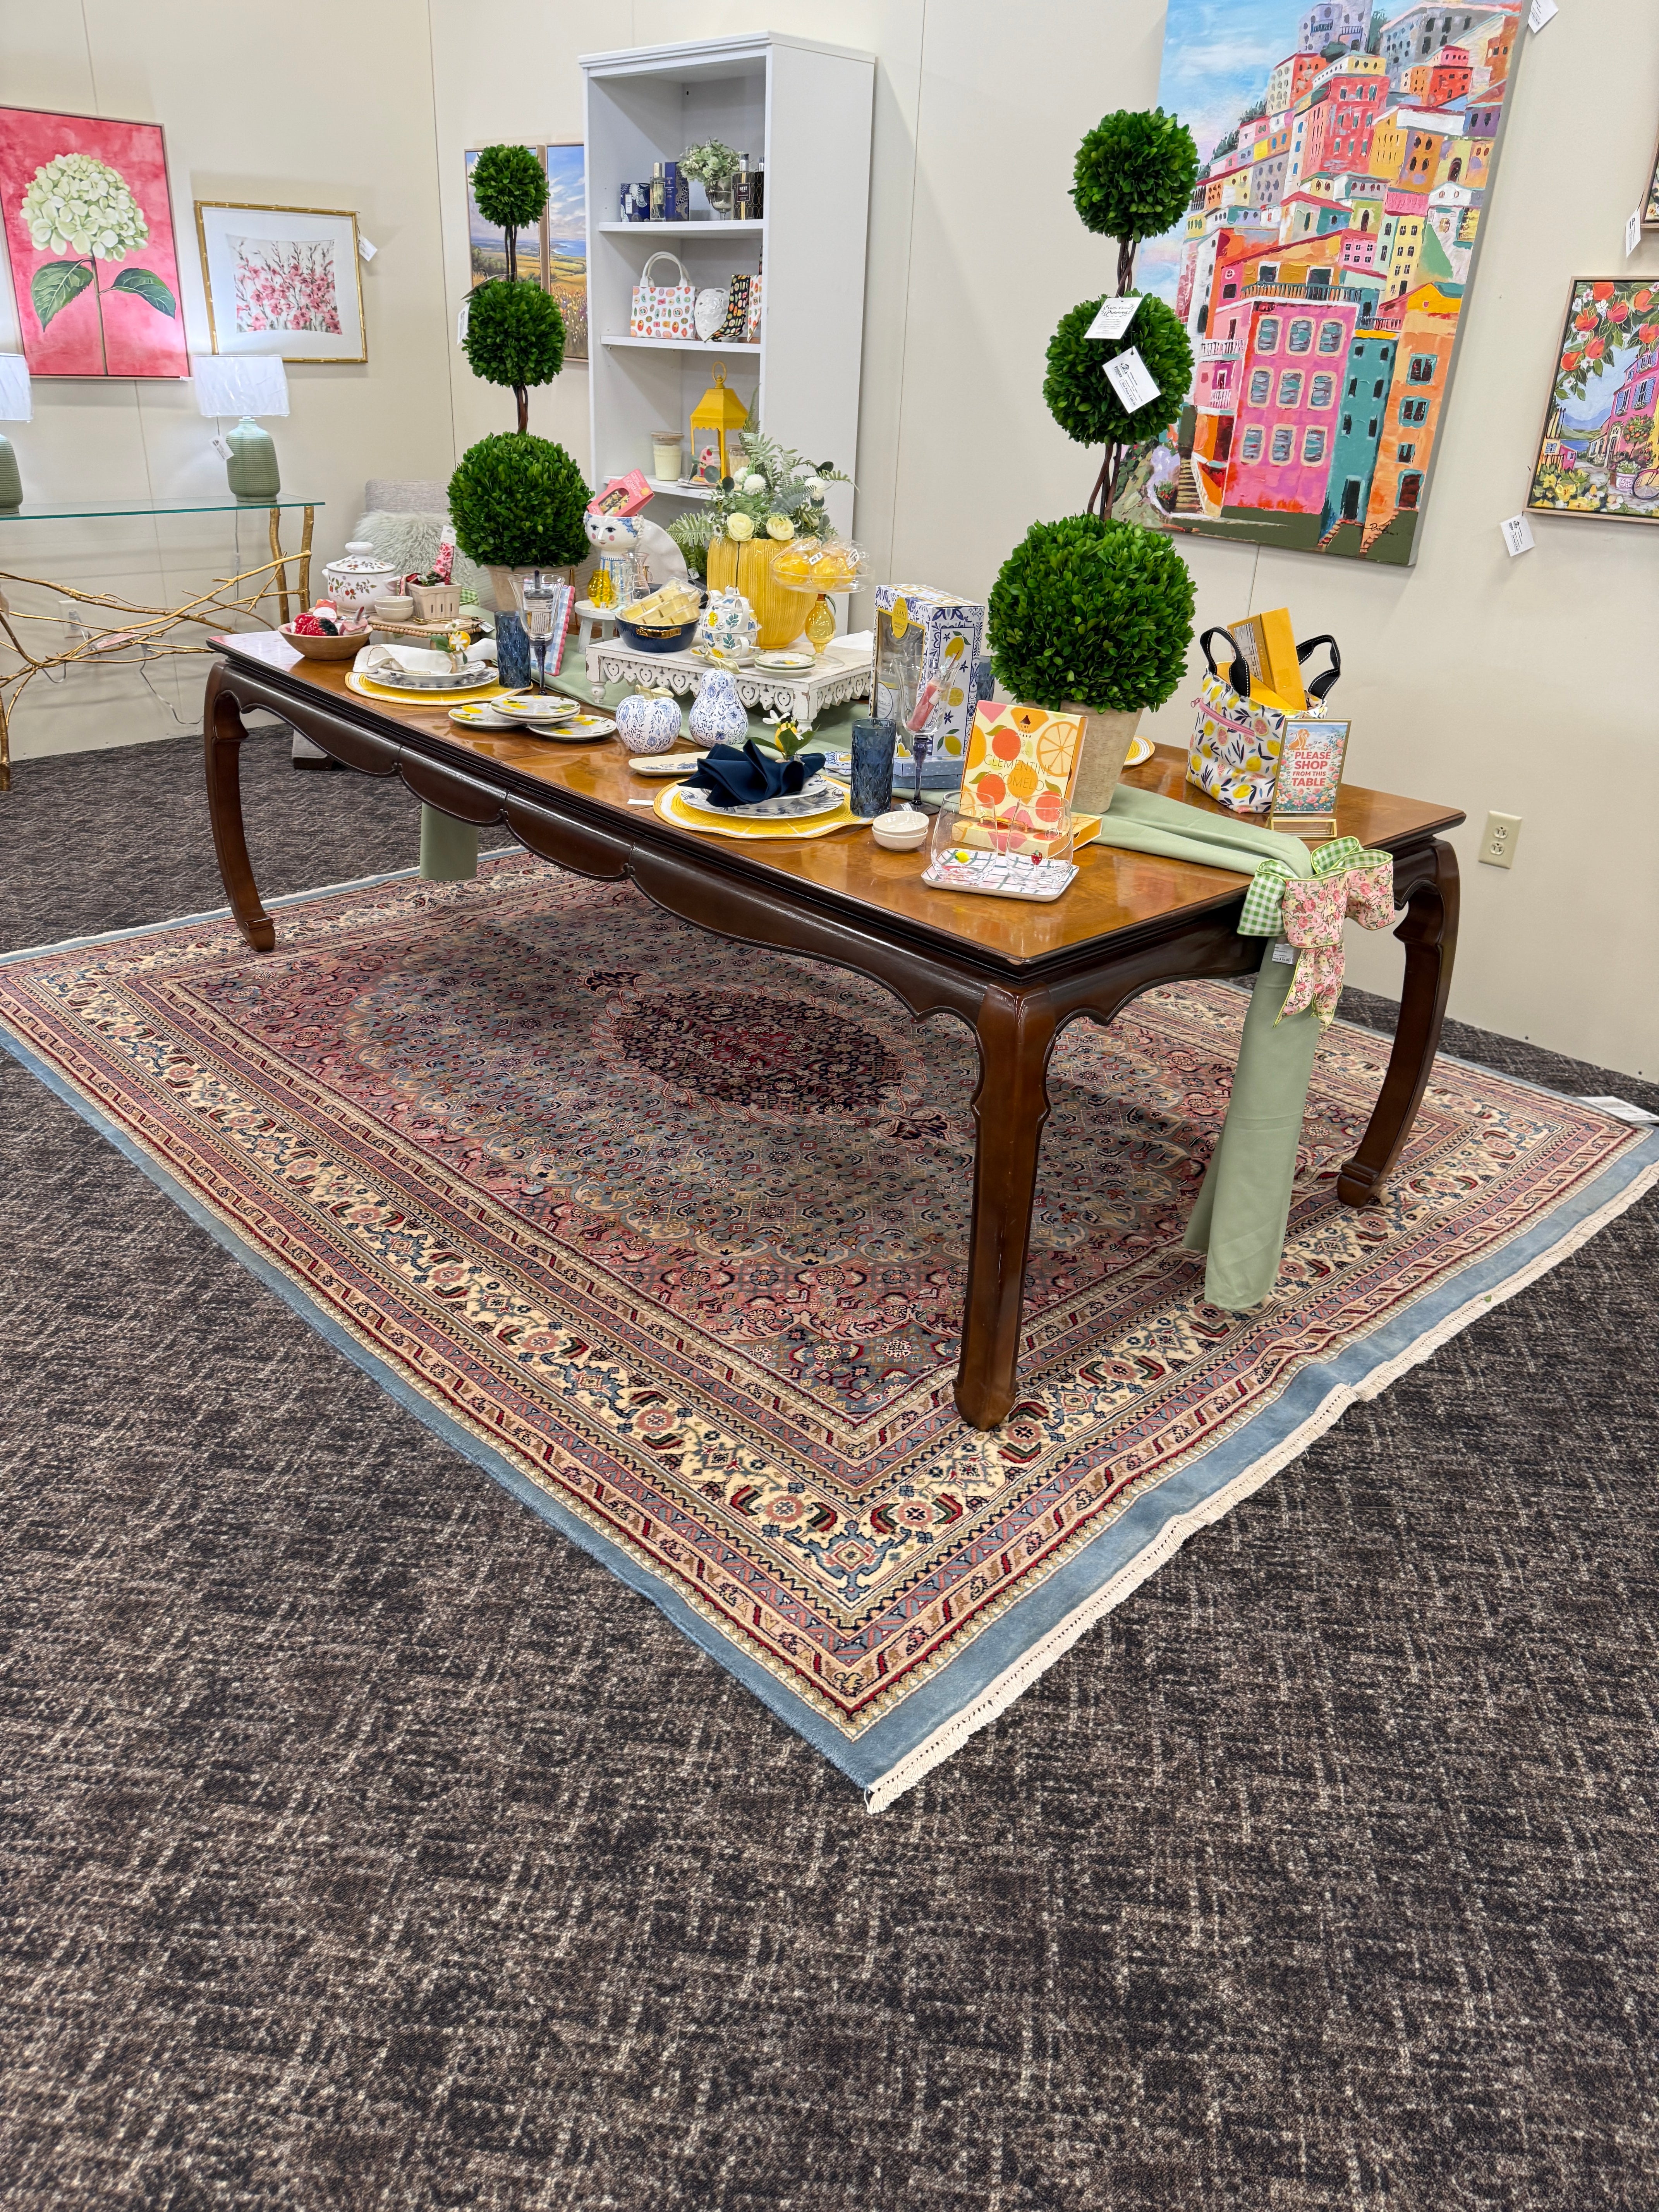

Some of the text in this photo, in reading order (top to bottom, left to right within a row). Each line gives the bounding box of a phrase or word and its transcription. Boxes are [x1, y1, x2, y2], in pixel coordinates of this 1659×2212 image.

[984, 754, 1052, 776] CLEMENTINE
[1294, 761, 1328, 769] SHOP
[1291, 778, 1326, 786] TABLE
